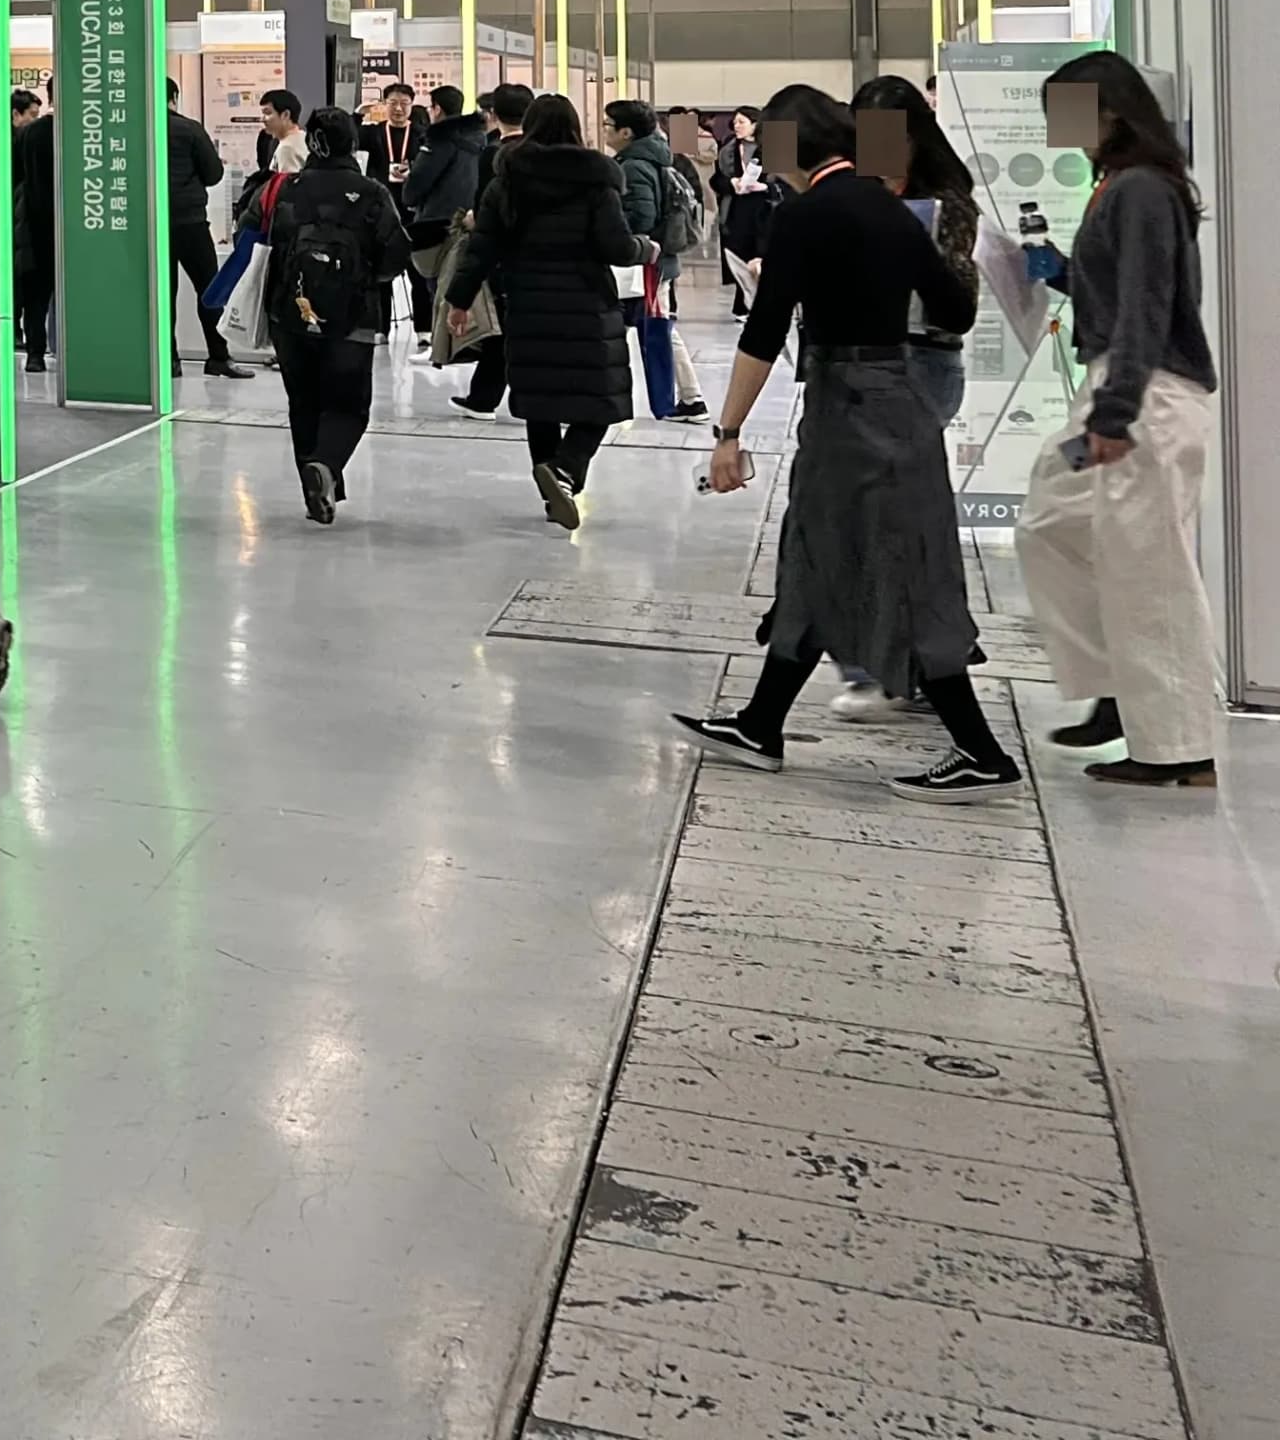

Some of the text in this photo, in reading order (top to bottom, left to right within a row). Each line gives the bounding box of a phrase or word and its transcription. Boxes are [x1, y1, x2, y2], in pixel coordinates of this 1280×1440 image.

[108, 50, 125, 122] 대한민국
[83, 100, 102, 171] KOREA
[84, 178, 104, 229] 2026
[110, 138, 127, 230] 교육박람회
